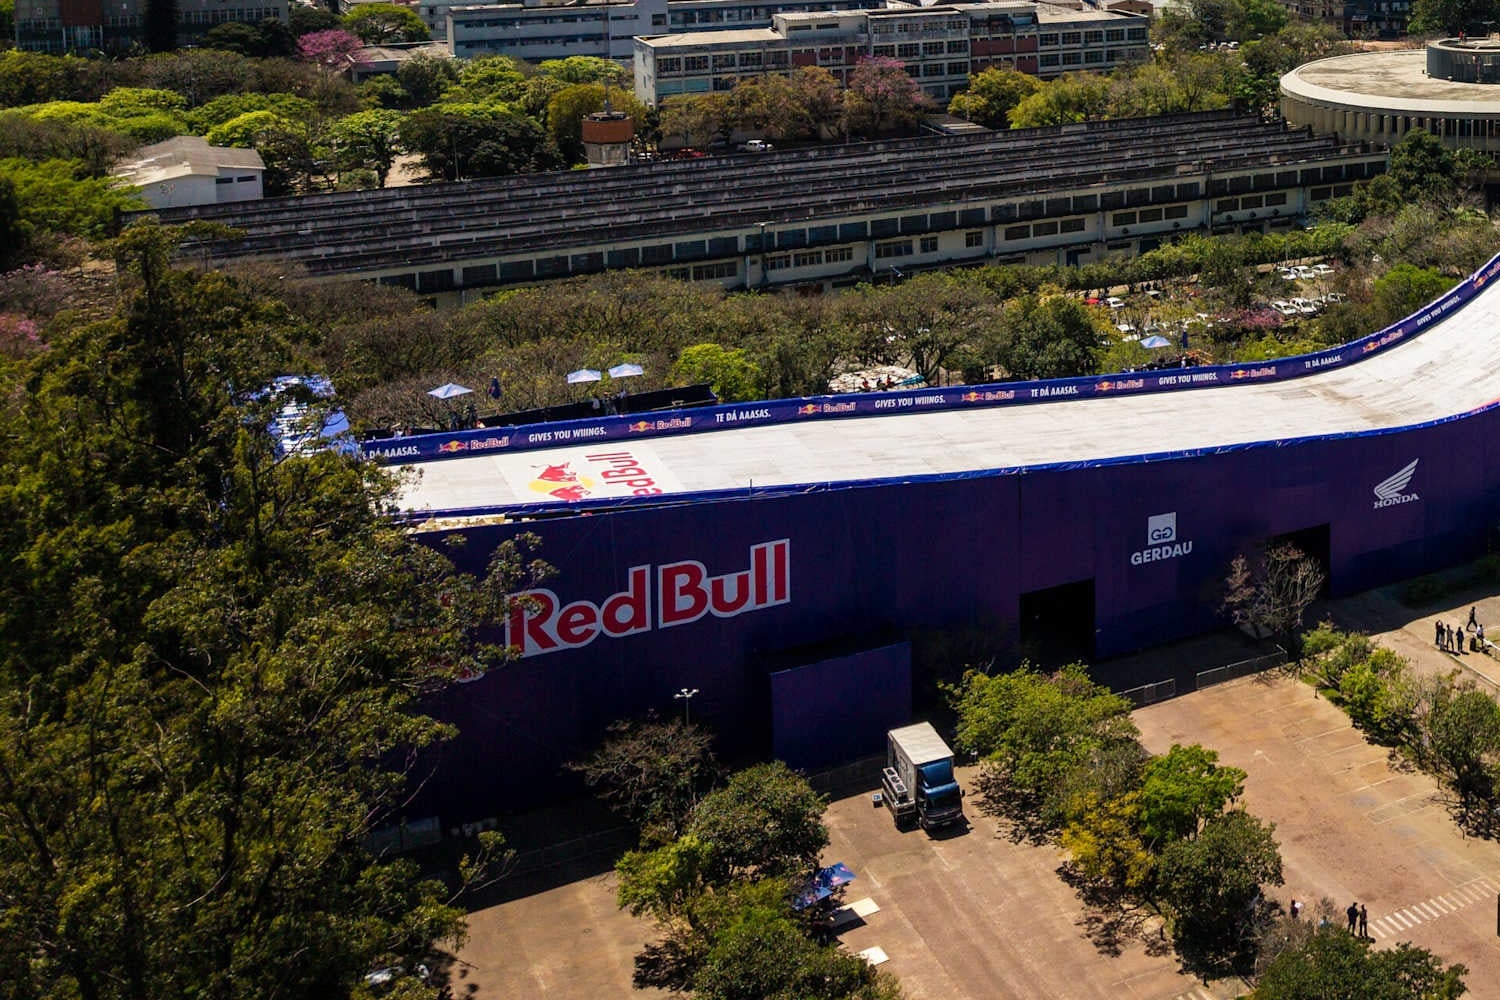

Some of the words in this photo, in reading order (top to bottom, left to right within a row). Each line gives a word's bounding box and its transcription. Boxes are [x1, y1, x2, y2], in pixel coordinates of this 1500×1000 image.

[1178, 374, 1191, 383] YOU
[1031, 389, 1038, 397] TE
[1040, 386, 1049, 396] DÁ
[875, 399, 896, 408] GIVES
[898, 397, 912, 407] YOU
[715, 413, 724, 423] TE
[726, 410, 737, 422] DÁ
[739, 409, 771, 420] AAASAS.
[528, 432, 552, 443] GIVES
[554, 429, 571, 440] YOU
[384, 446, 420, 458] AAASAS.
[1374, 493, 1419, 509] HONDA
[1131, 541, 1193, 565] GERDAU
[660, 540, 788, 626] Bull
